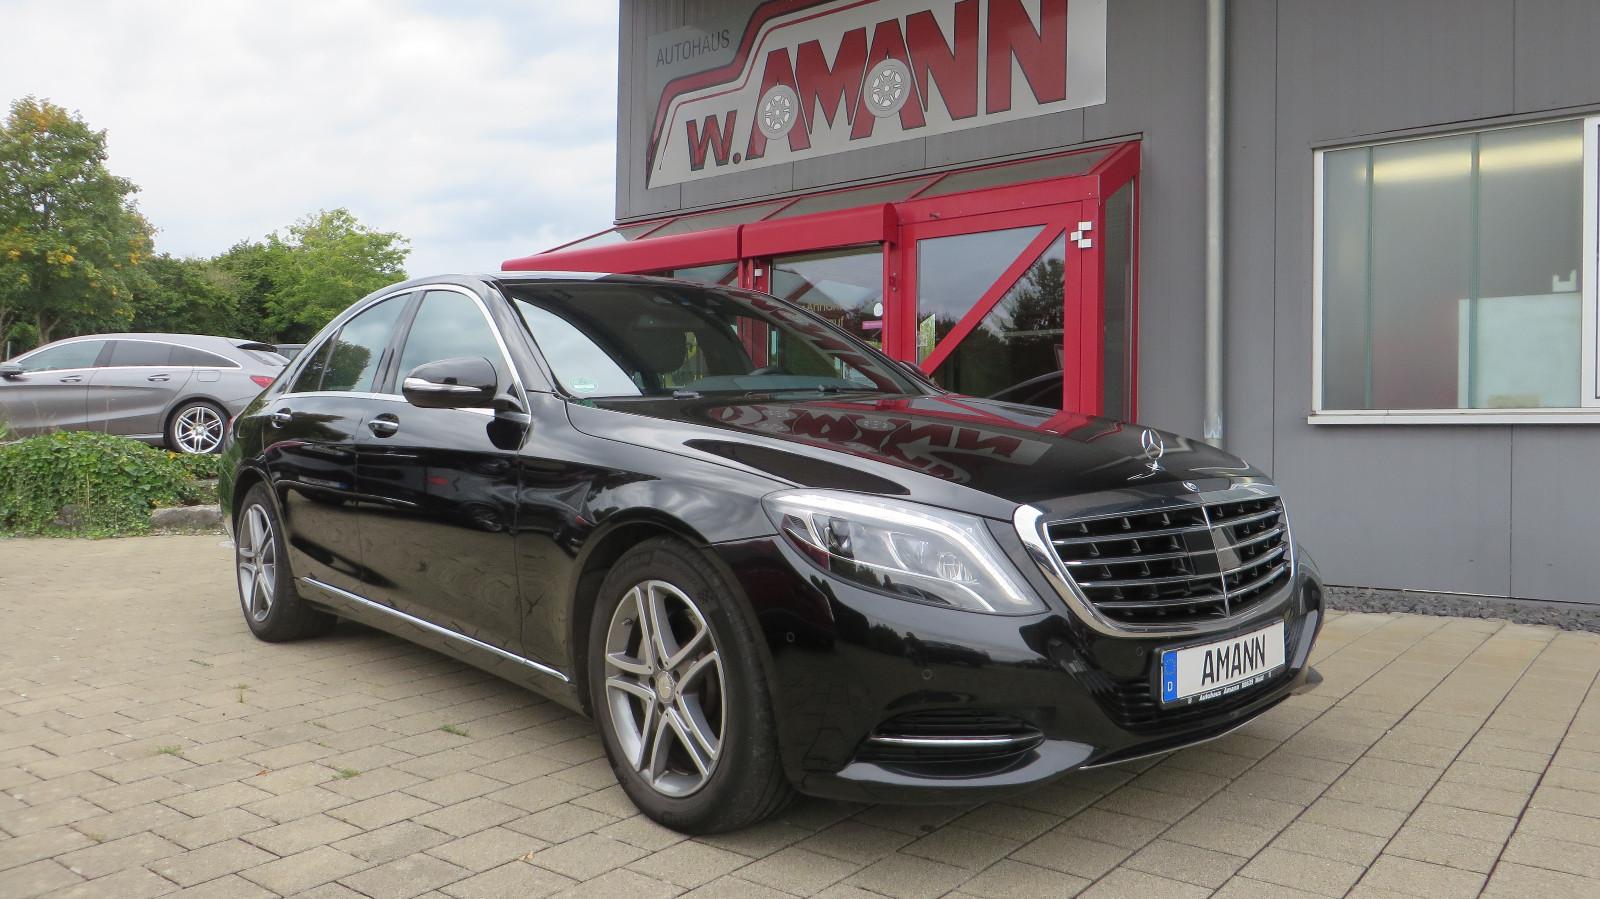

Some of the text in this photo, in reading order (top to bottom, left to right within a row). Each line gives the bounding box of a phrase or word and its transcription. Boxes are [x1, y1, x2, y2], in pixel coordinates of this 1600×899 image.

[656, 29, 730, 67] AUTOHAUS
[745, 0, 1068, 160] AMANN
[1202, 634, 1265, 686] AMANN
[1167, 681, 1173, 692] D
[1199, 691, 1222, 701] Autohaus
[1224, 685, 1239, 694] Amann
